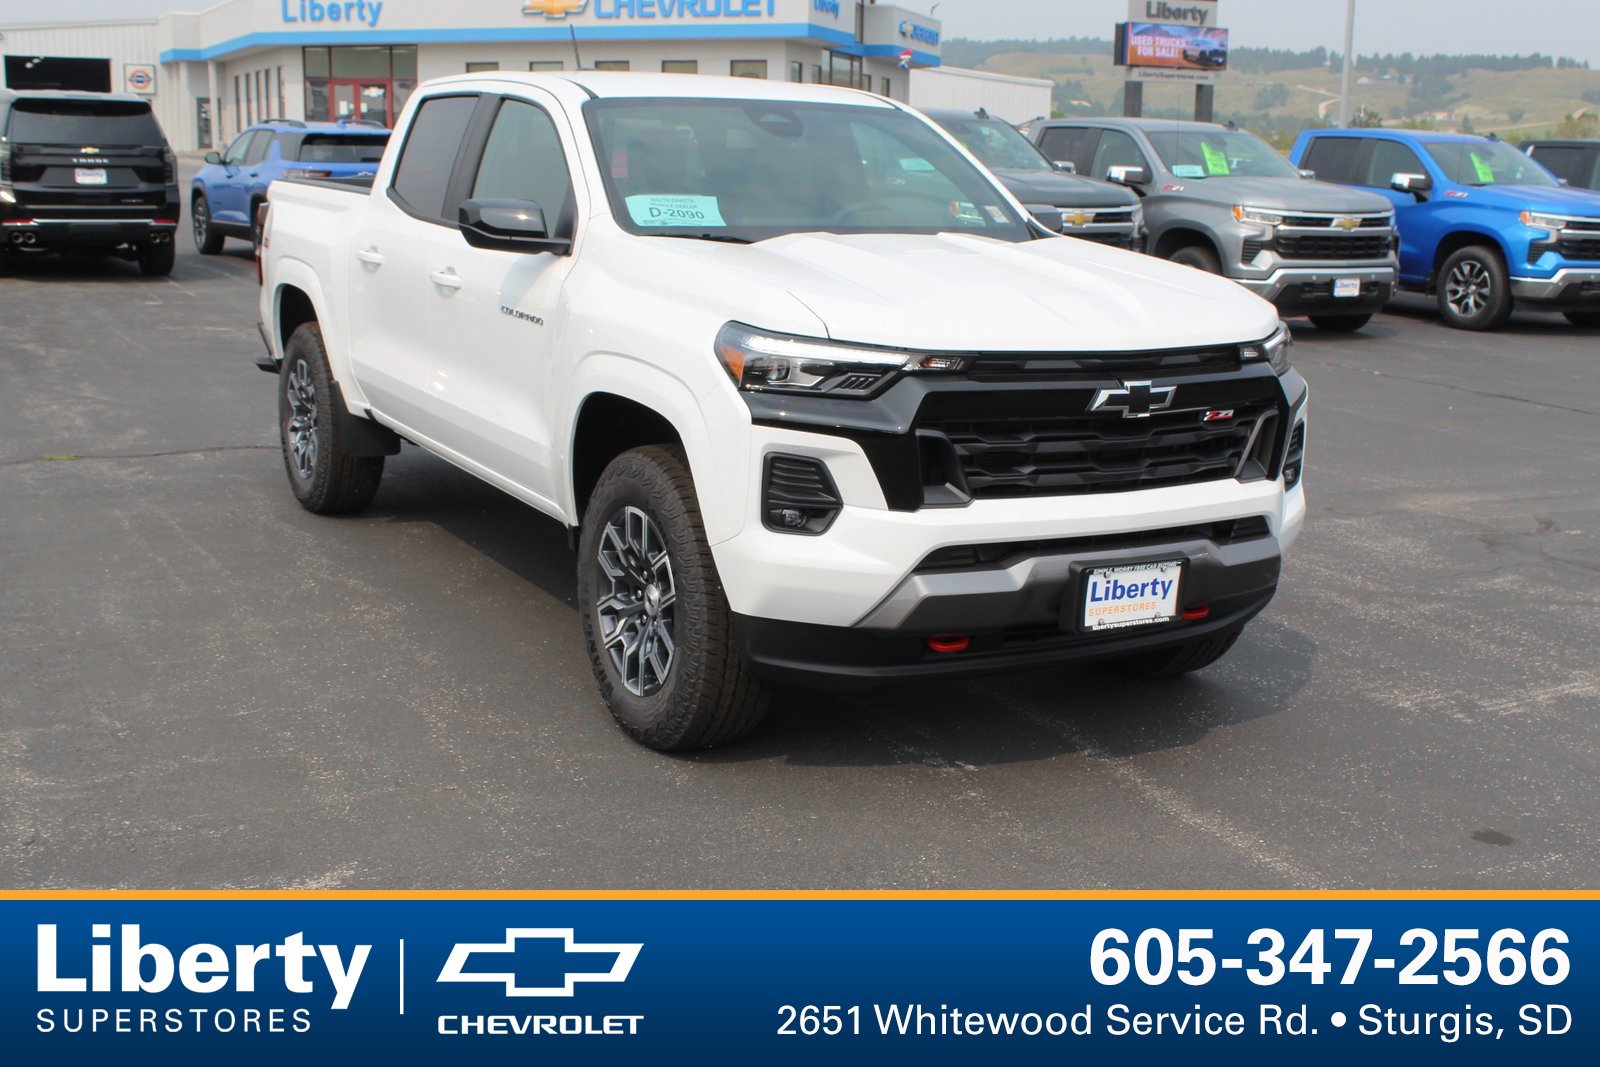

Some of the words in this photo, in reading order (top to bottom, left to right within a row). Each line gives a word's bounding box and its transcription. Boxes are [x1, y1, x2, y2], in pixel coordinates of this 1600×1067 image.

[282, 0, 383, 27] Liberty
[594, 0, 775, 18] CHEVROLET
[1146, 1, 1208, 24] Liberty
[1131, 36, 1153, 46] USED
[1155, 37, 1186, 48] TRUCKS
[1137, 47, 1153, 57] FOR
[649, 206, 705, 220] D-2090
[501, 305, 544, 326] COLORADO
[1090, 577, 1173, 603] Liberty
[1088, 601, 1157, 617] SUPERSTORES
[1092, 616, 1170, 631] libertysuperstores.com
